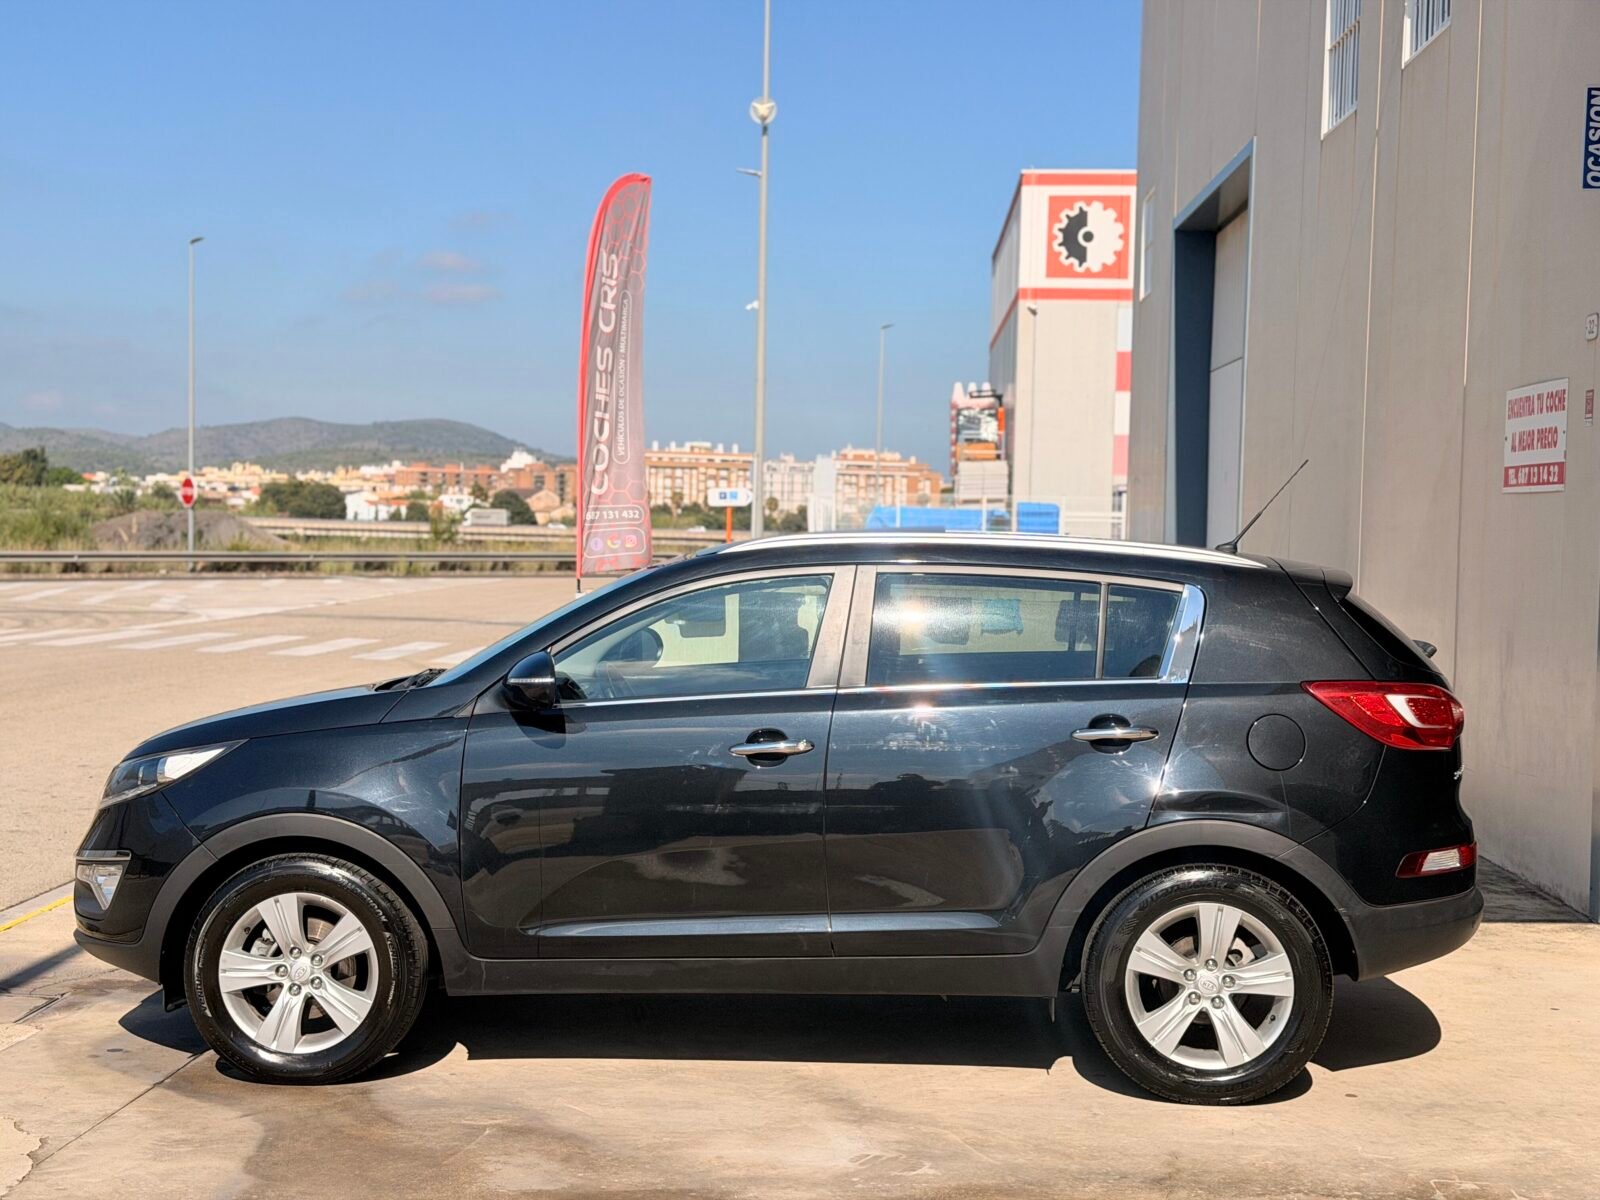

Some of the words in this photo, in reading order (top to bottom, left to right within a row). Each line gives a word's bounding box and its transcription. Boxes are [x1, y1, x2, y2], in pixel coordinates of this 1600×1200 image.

[619, 298, 629, 354] MULTIMARCA
[618, 397, 625, 410] DE
[1537, 393, 1544, 415] TU
[1546, 389, 1566, 413] COCHE
[591, 345, 614, 495] COCHES
[1511, 432, 1517, 453] AL
[1518, 429, 1535, 451] MEJOR
[1537, 426, 1558, 449] PRECIO
[1530, 465, 1538, 484] 13
[1539, 465, 1549, 483] 14
[1549, 464, 1559, 483] 32
[602, 510, 619, 520] 131
[621, 509, 640, 519] 432
